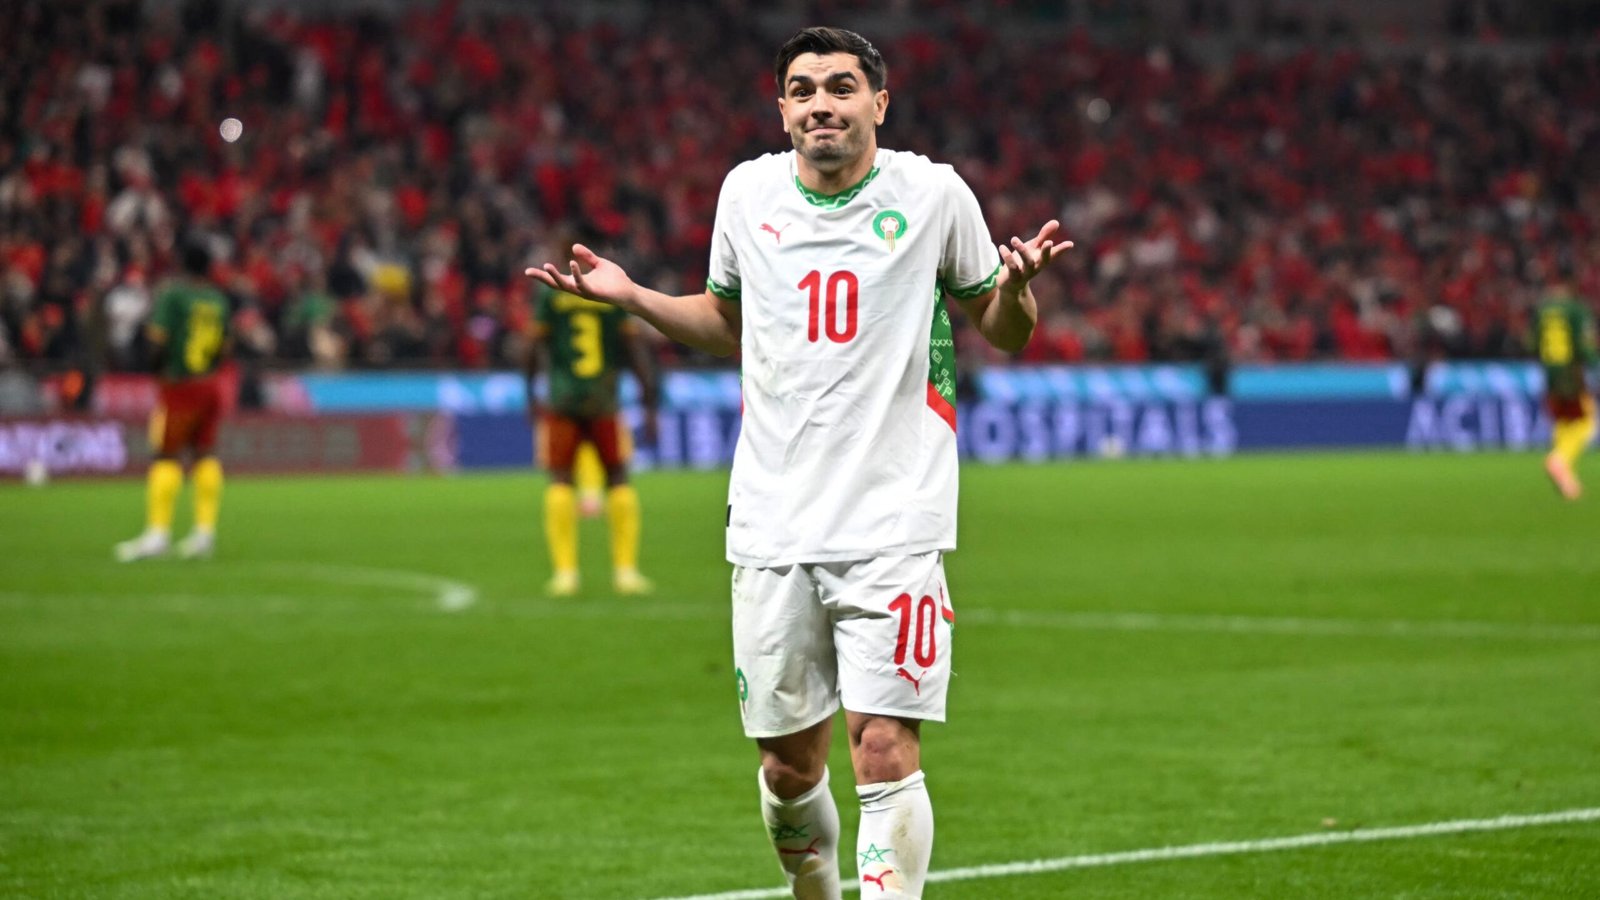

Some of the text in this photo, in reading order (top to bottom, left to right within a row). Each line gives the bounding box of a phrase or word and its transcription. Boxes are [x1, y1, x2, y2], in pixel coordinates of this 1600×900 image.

[797, 270, 859, 343] 10
[571, 311, 603, 377] 3
[956, 399, 1237, 461] OSPITALS
[888, 592, 936, 668] 10
